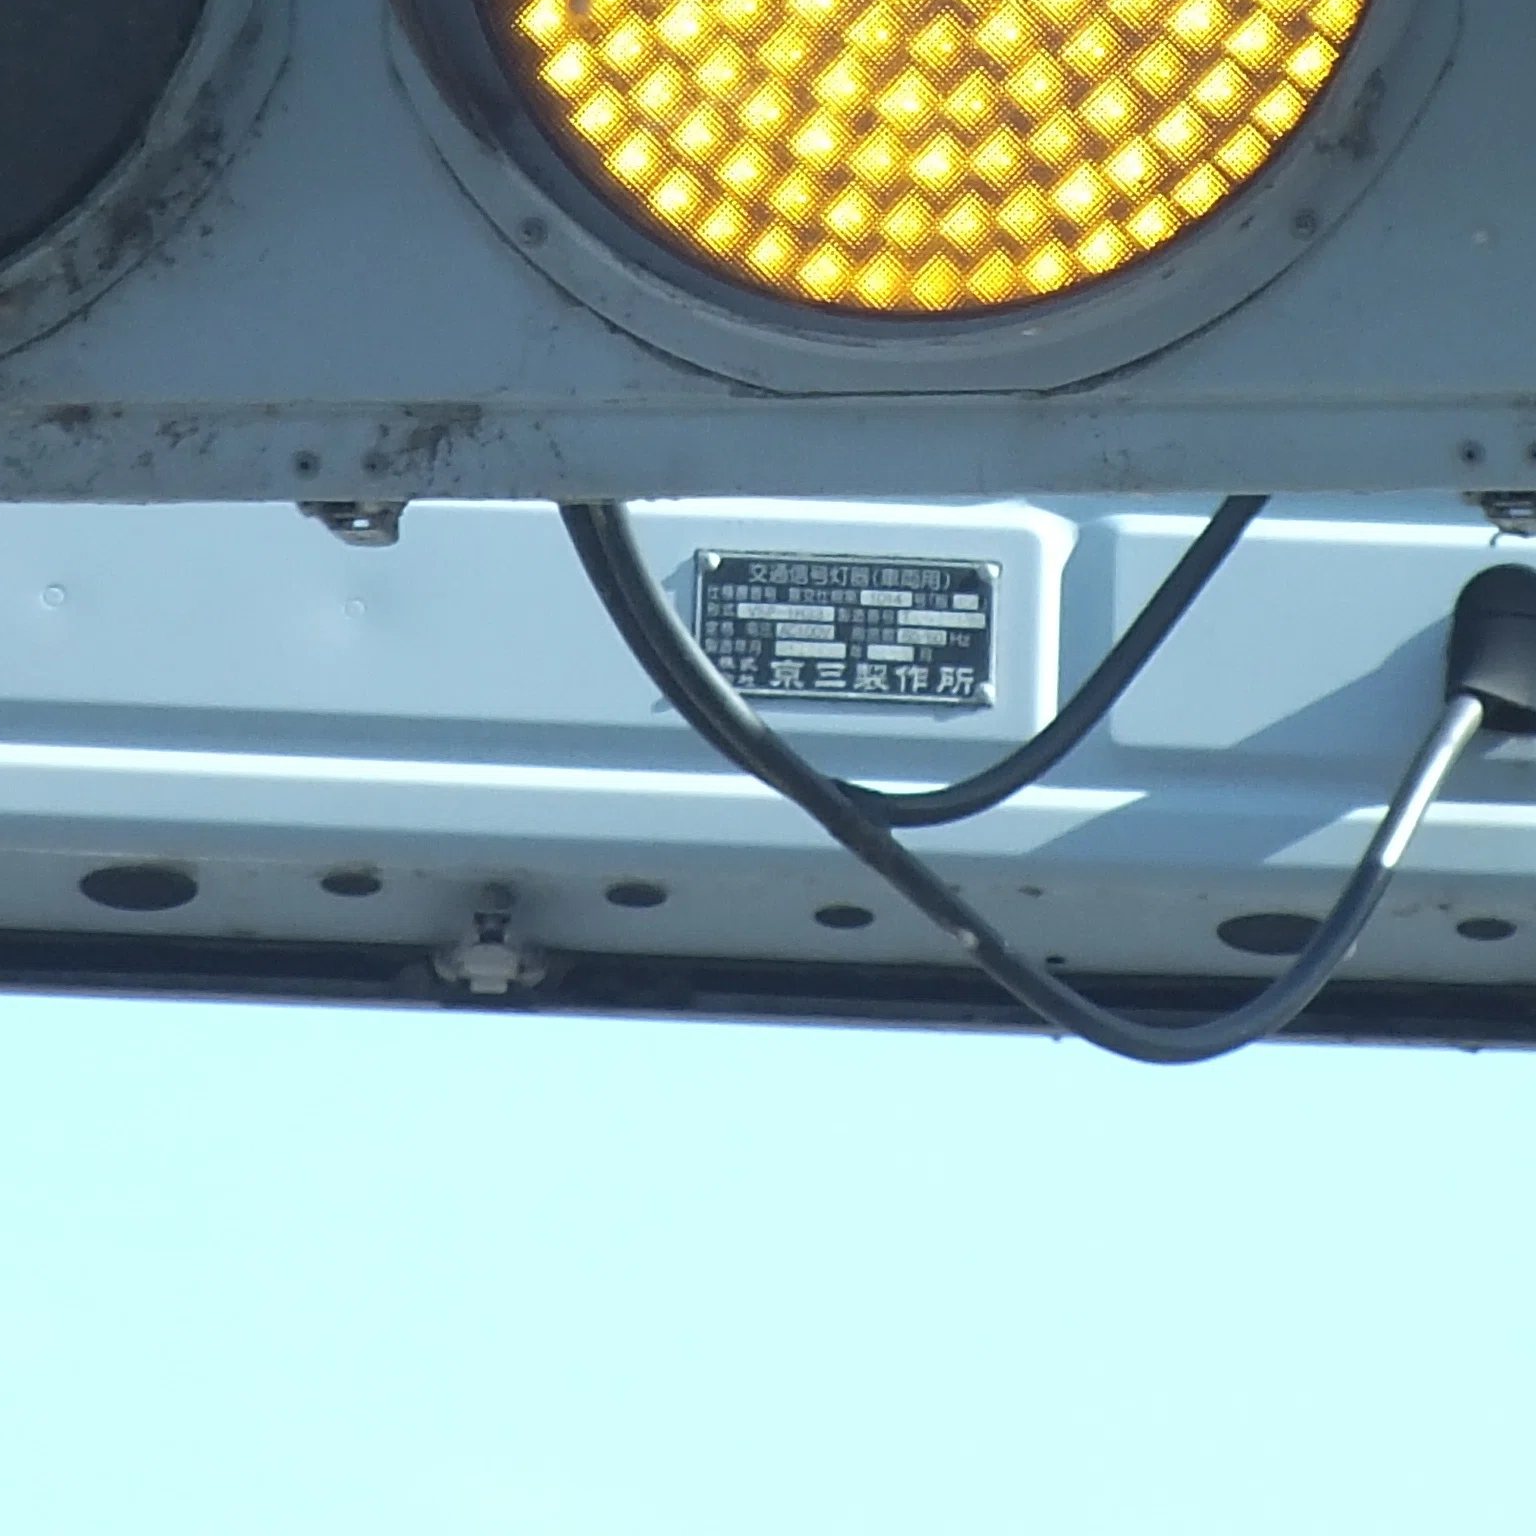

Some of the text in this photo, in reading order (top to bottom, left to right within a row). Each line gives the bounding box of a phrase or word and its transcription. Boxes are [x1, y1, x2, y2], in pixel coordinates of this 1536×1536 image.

[769, 659, 974, 695] 京三製作所
